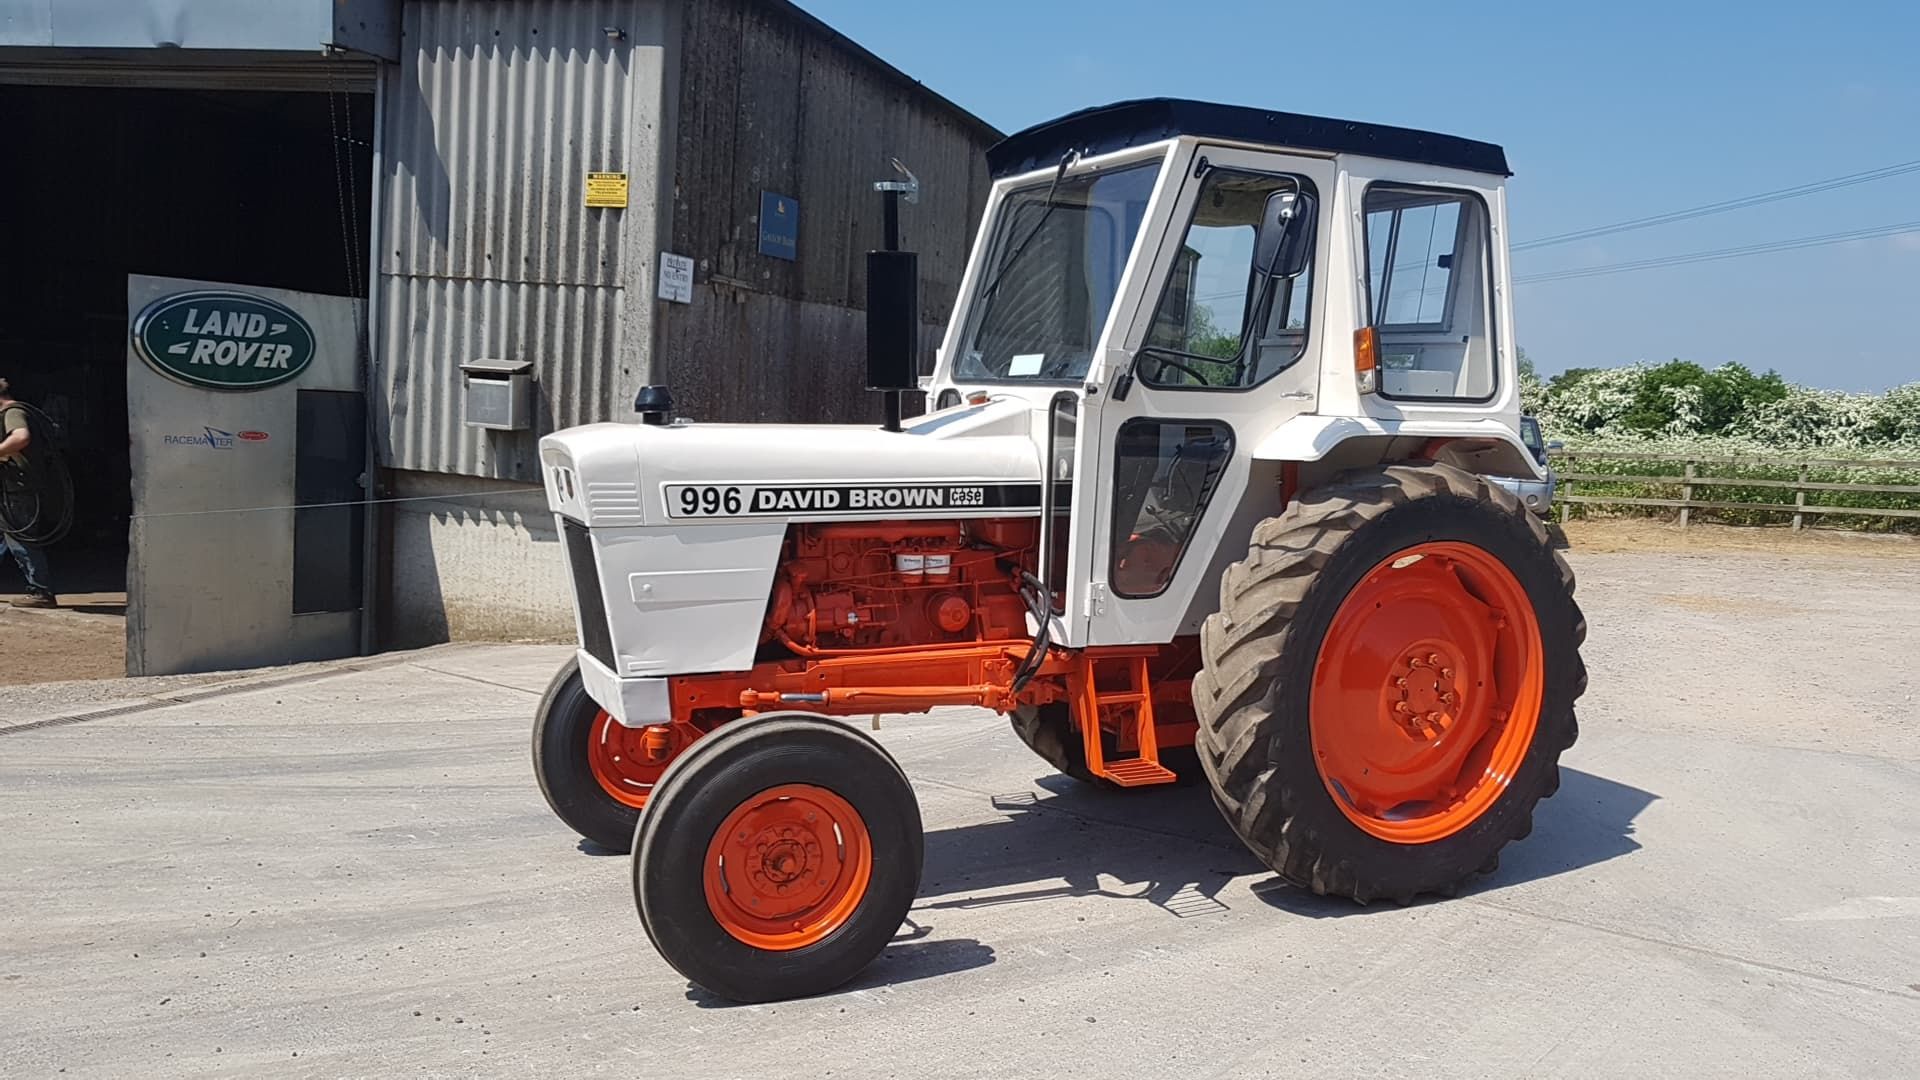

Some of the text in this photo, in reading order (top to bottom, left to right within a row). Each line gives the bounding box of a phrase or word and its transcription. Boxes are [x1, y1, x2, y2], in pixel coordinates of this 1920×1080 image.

[182, 308, 267, 338] LAND
[189, 339, 293, 369] ROVER
[680, 487, 742, 515] 996
[758, 490, 840, 510] DAVID
[849, 488, 943, 508] BROWN
